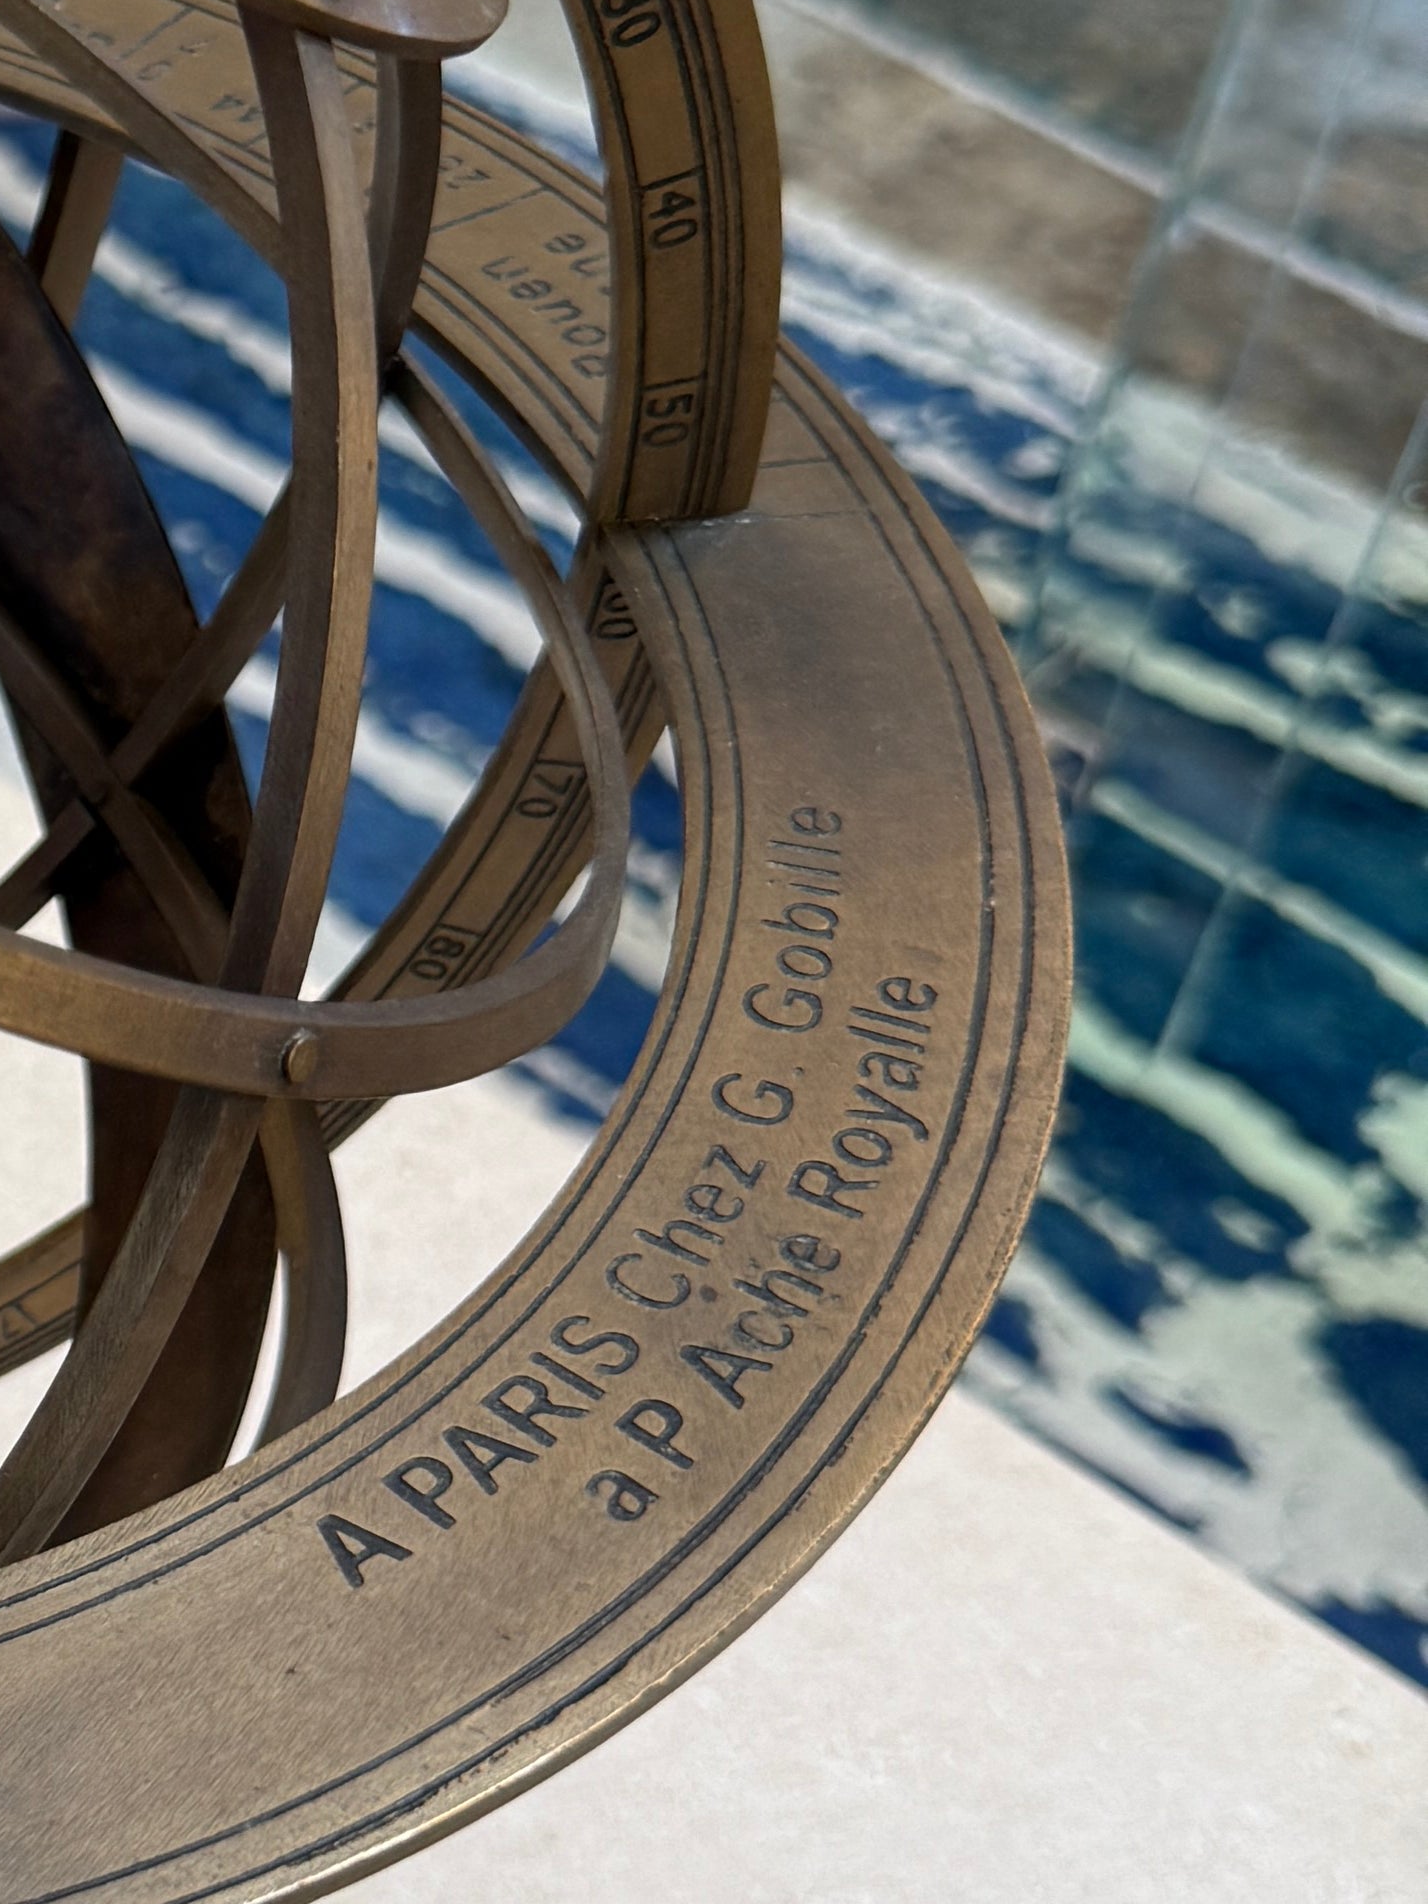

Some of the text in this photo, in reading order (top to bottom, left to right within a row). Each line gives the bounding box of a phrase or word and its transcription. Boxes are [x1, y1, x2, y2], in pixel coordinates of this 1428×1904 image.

[646, 190, 698, 252] 40
[643, 391, 694, 450] 50
[514, 767, 574, 819] 70
[409, 934, 465, 982] 80
[315, 803, 845, 1592] A PARIS Chez G. Gobille
[679, 1234, 844, 1411] Ache
[786, 973, 940, 1221] Royalle
